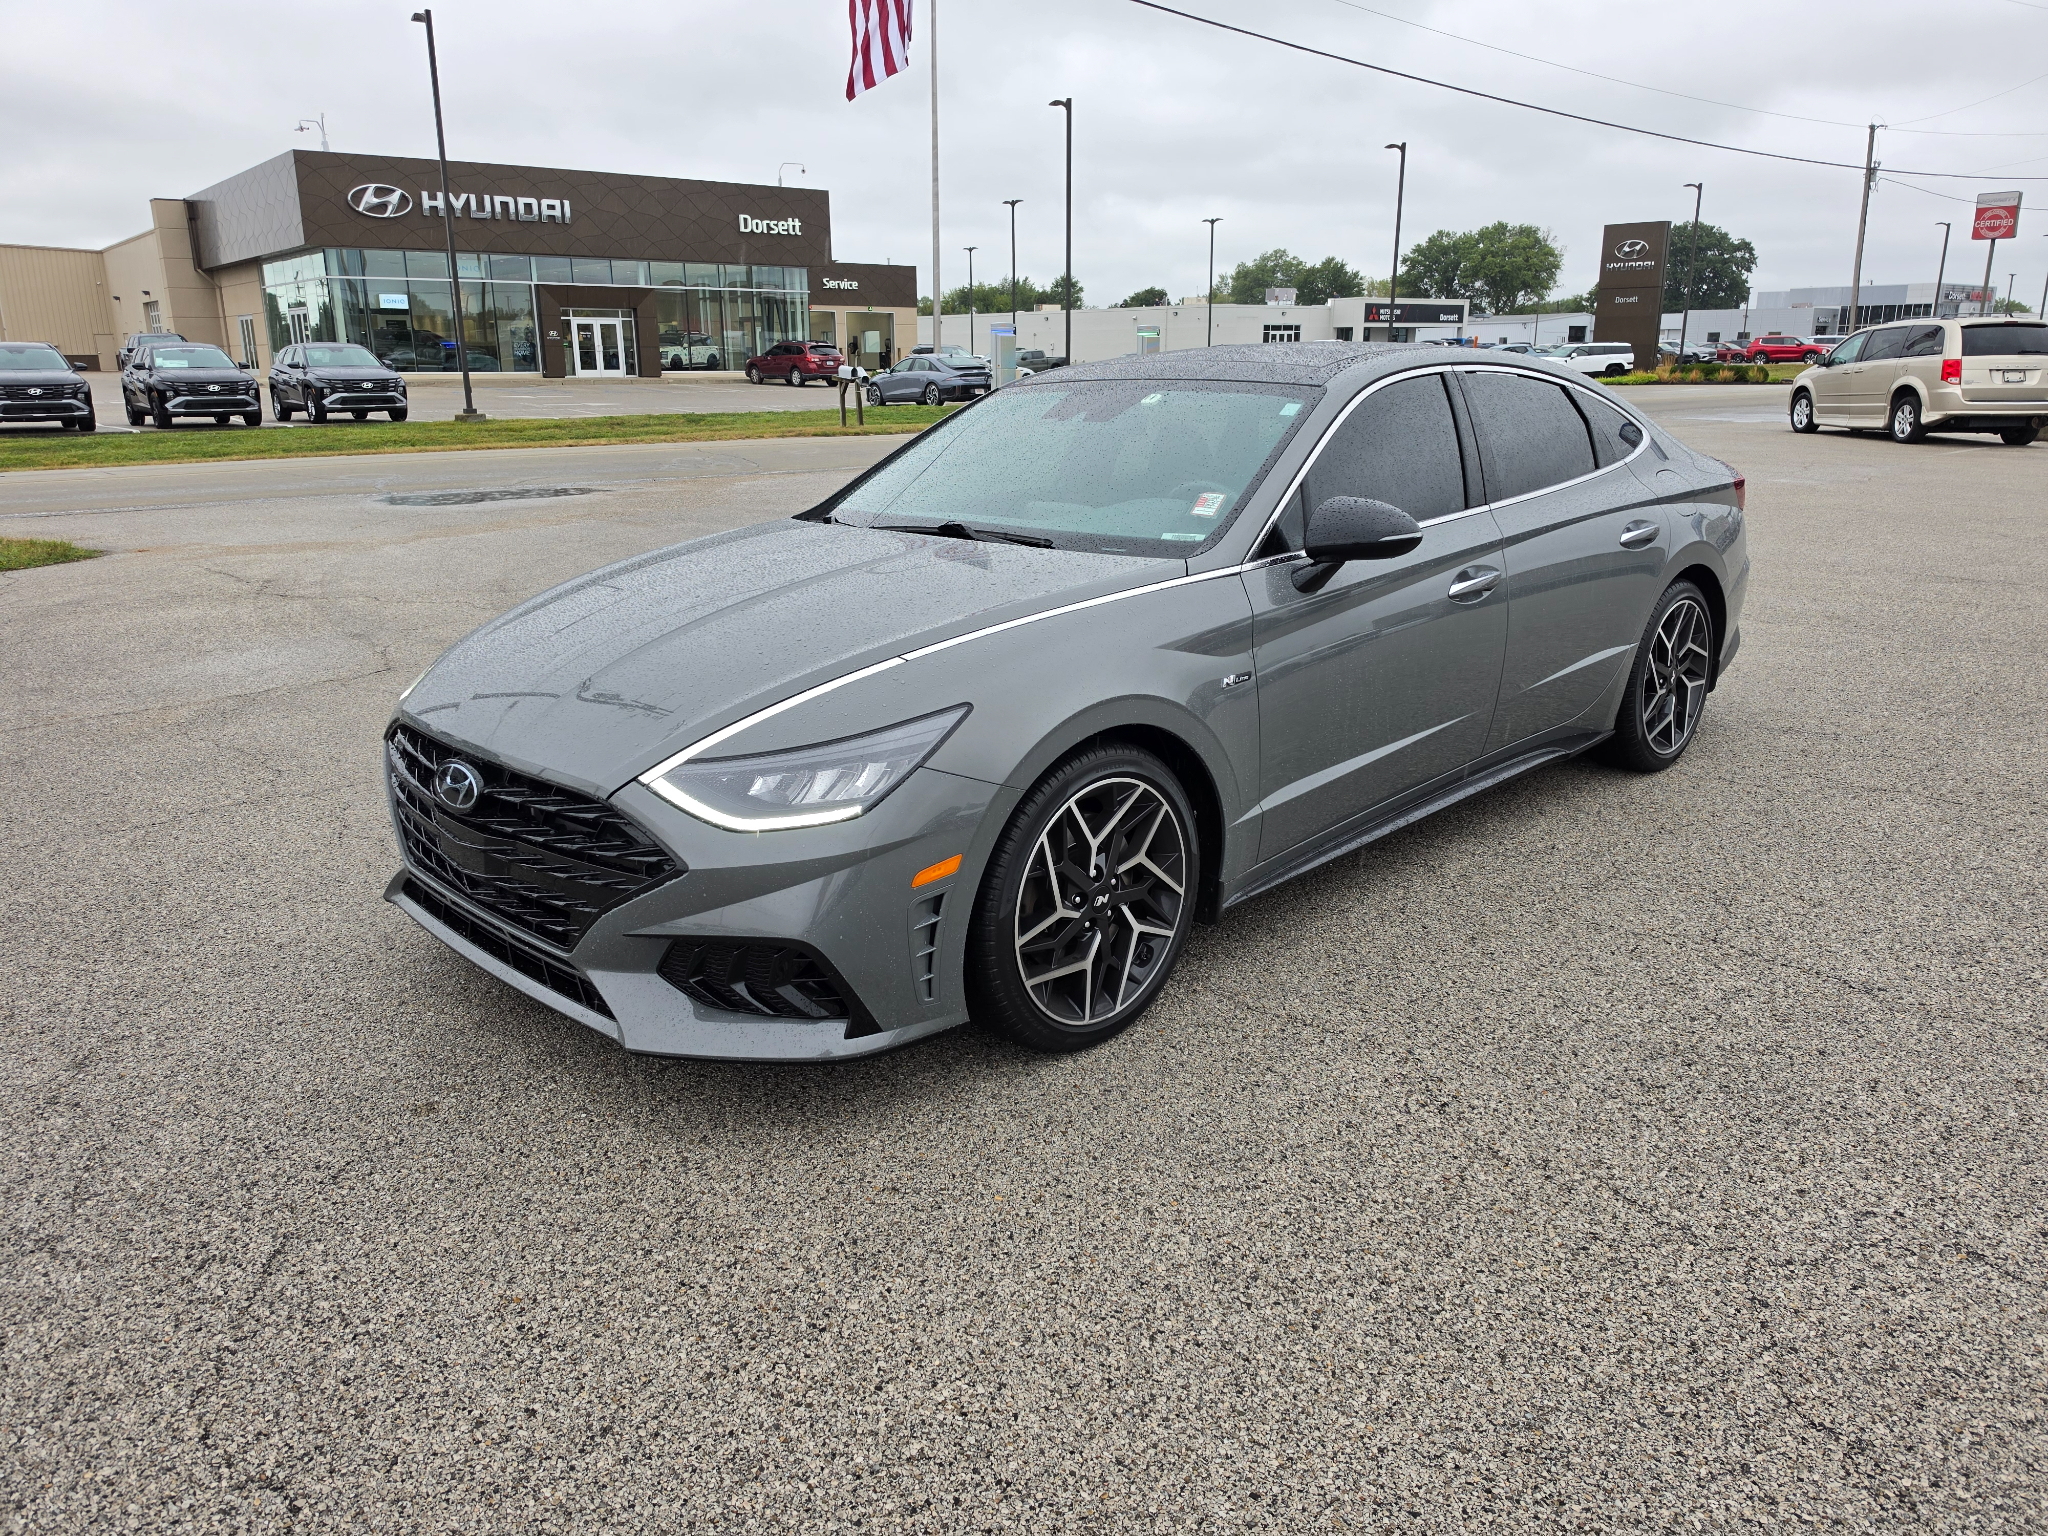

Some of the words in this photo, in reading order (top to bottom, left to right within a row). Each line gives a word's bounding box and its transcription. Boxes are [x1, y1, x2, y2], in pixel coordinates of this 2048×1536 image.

[421, 190, 571, 224] HYUNDAI
[738, 214, 802, 236] Dorsett
[1975, 218, 2014, 228] CERTIFIED
[1606, 261, 1655, 271] HYUNDAI
[822, 277, 859, 290] Service
[1615, 295, 1638, 304] Dorsett
[1440, 313, 1459, 321] Dorsett
